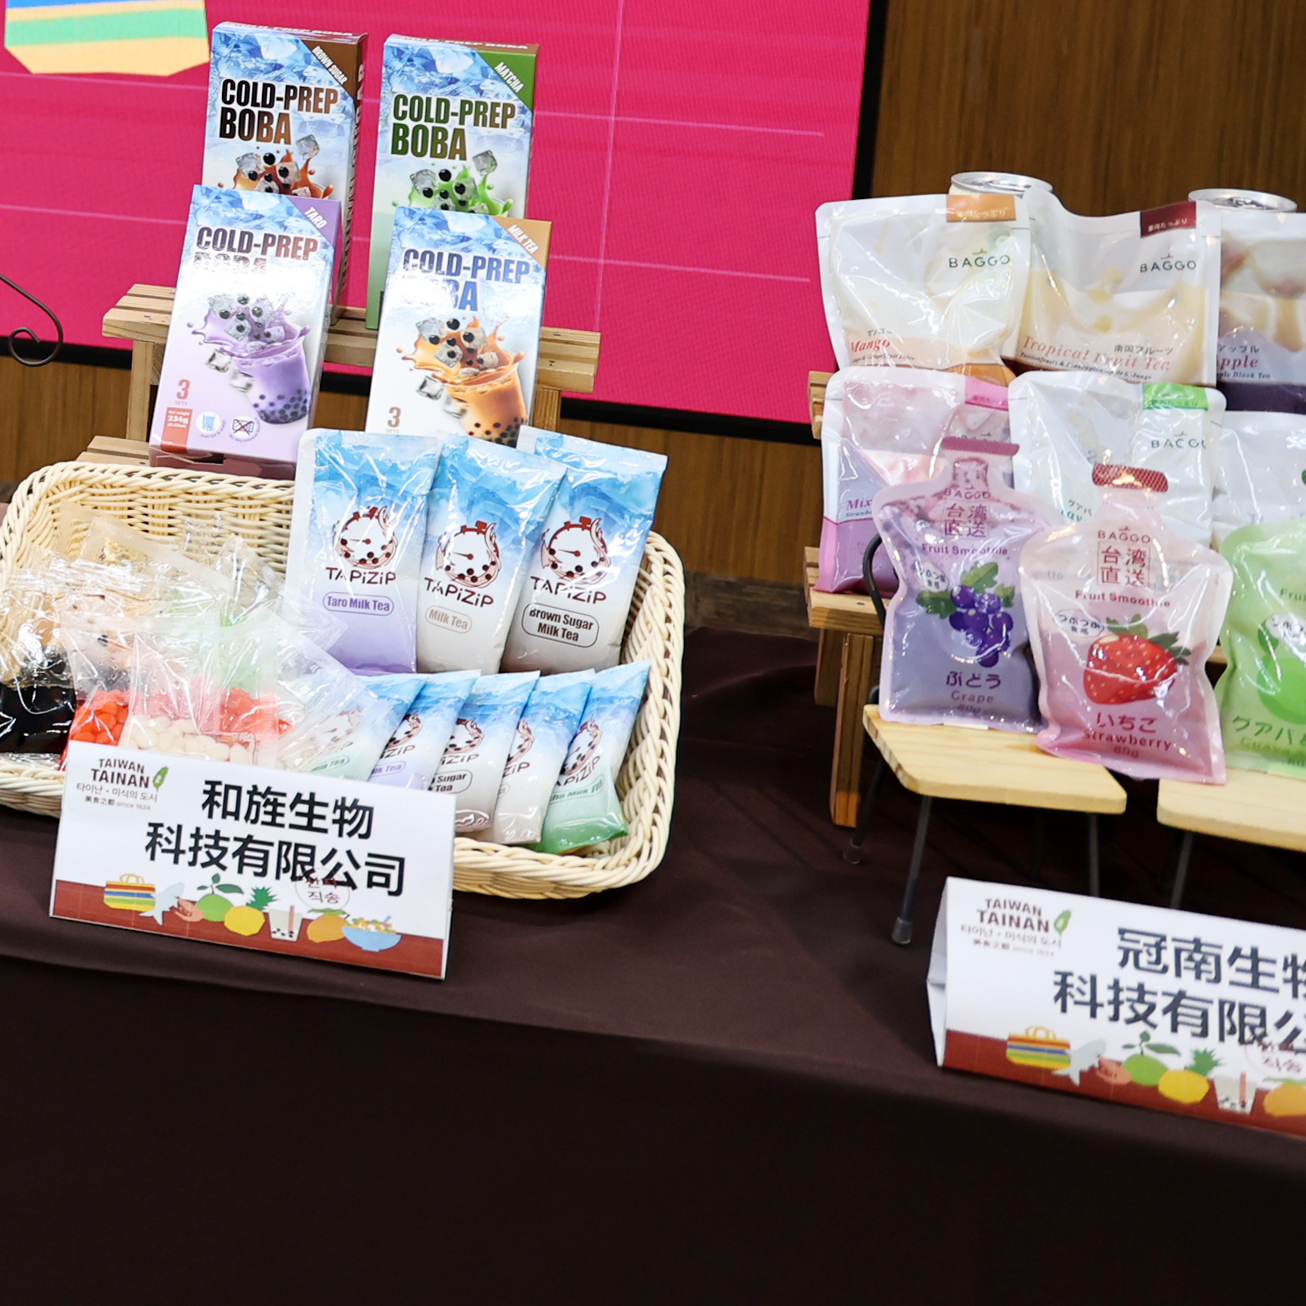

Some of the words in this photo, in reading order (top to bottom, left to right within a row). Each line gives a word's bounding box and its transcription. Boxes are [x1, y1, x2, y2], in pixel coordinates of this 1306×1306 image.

[311, 45, 330, 68] BROWN
[327, 62, 348, 85] SUGAR
[493, 61, 525, 93] MATCHA
[220, 78, 338, 114] COLD-PREP
[393, 94, 516, 130] COLD-PREP
[218, 106, 292, 145] BOBA
[390, 123, 467, 161] BOBA
[305, 206, 327, 230] TARO
[195, 225, 318, 261] COLD-PREP
[507, 223, 527, 246] MILK
[522, 237, 539, 255] TEA
[401, 248, 531, 285] COLD-PREP
[948, 254, 1011, 269] BAGGO
[1139, 259, 1197, 274] BAGGO
[851, 337, 891, 353] Mango
[1023, 334, 1090, 361] Tropical
[1094, 351, 1139, 369] Fruit
[1113, 344, 1174, 356] 南国フルーツ
[176, 379, 190, 400] 3
[387, 406, 401, 428] 3
[944, 487, 992, 500] BAGGO
[846, 497, 873, 511] Mix
[945, 503, 988, 520] 台湾
[944, 519, 987, 538] 直送
[1097, 529, 1151, 544] BAGGO
[922, 543, 949, 555] Fruit
[1100, 546, 1148, 568] 台湾
[1099, 567, 1147, 586] 直送
[327, 595, 348, 609] Taro
[348, 597, 370, 611] Milk
[369, 598, 390, 612] Tea
[1075, 590, 1107, 602] Fruit
[1109, 593, 1171, 608] Smoothie
[428, 608, 448, 625] Milk
[448, 614, 469, 631] Tea
[529, 606, 561, 625] Brown
[561, 613, 594, 633] Sugar
[537, 622, 556, 639] Milk
[556, 626, 579, 643] Tea
[945, 670, 1002, 690] ぶどう
[951, 689, 995, 704] Grape
[1096, 712, 1158, 734] いちご
[1083, 729, 1173, 752] Strawberry
[98, 758, 145, 773] TAIWAN
[90, 768, 149, 789] TAINAN
[435, 784, 453, 793] Tea
[436, 773, 467, 784] Sugar
[76, 782, 103, 794] 타이난
[112, 787, 138, 800] 미식의
[139, 790, 158, 802] 도시
[85, 795, 116, 807] 美食之都
[117, 800, 134, 808] since
[135, 802, 151, 811] 1624
[201, 780, 374, 840] 和旌生物
[144, 822, 405, 897] 科技有限公司
[307, 890, 339, 905] 직송
[984, 898, 1042, 916] TAIWAN
[976, 910, 1050, 933] TAINAN
